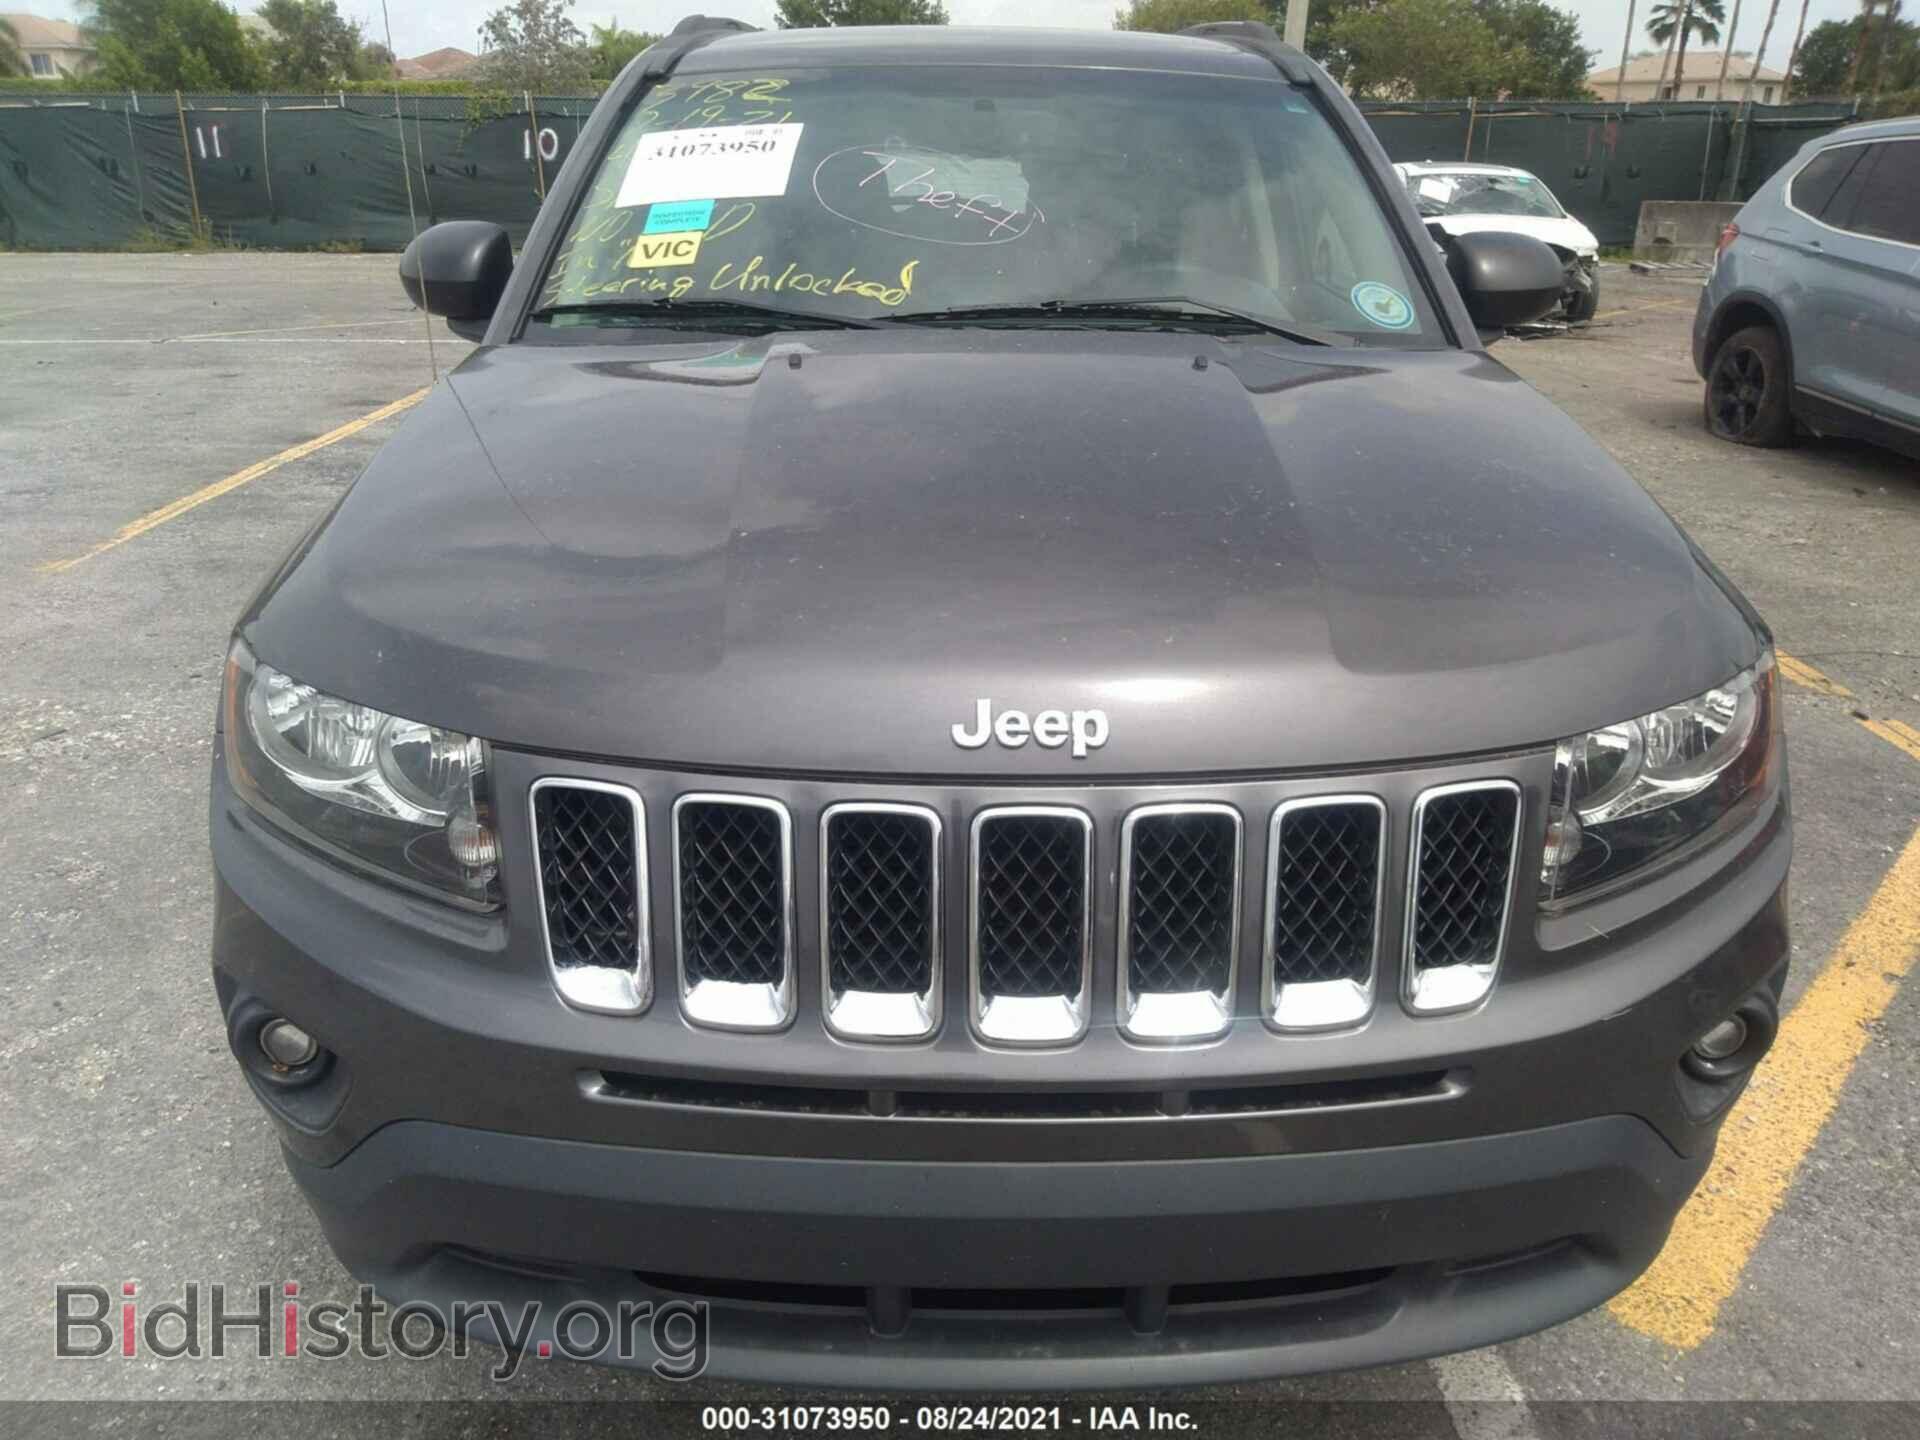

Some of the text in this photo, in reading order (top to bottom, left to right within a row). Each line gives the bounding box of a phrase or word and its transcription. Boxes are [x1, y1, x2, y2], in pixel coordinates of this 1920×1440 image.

[196, 126, 221, 159] 11
[524, 128, 559, 161] 10
[642, 240, 695, 259] VIC
[710, 256, 920, 305] Unlocked
[951, 698, 1109, 758] Jeep
